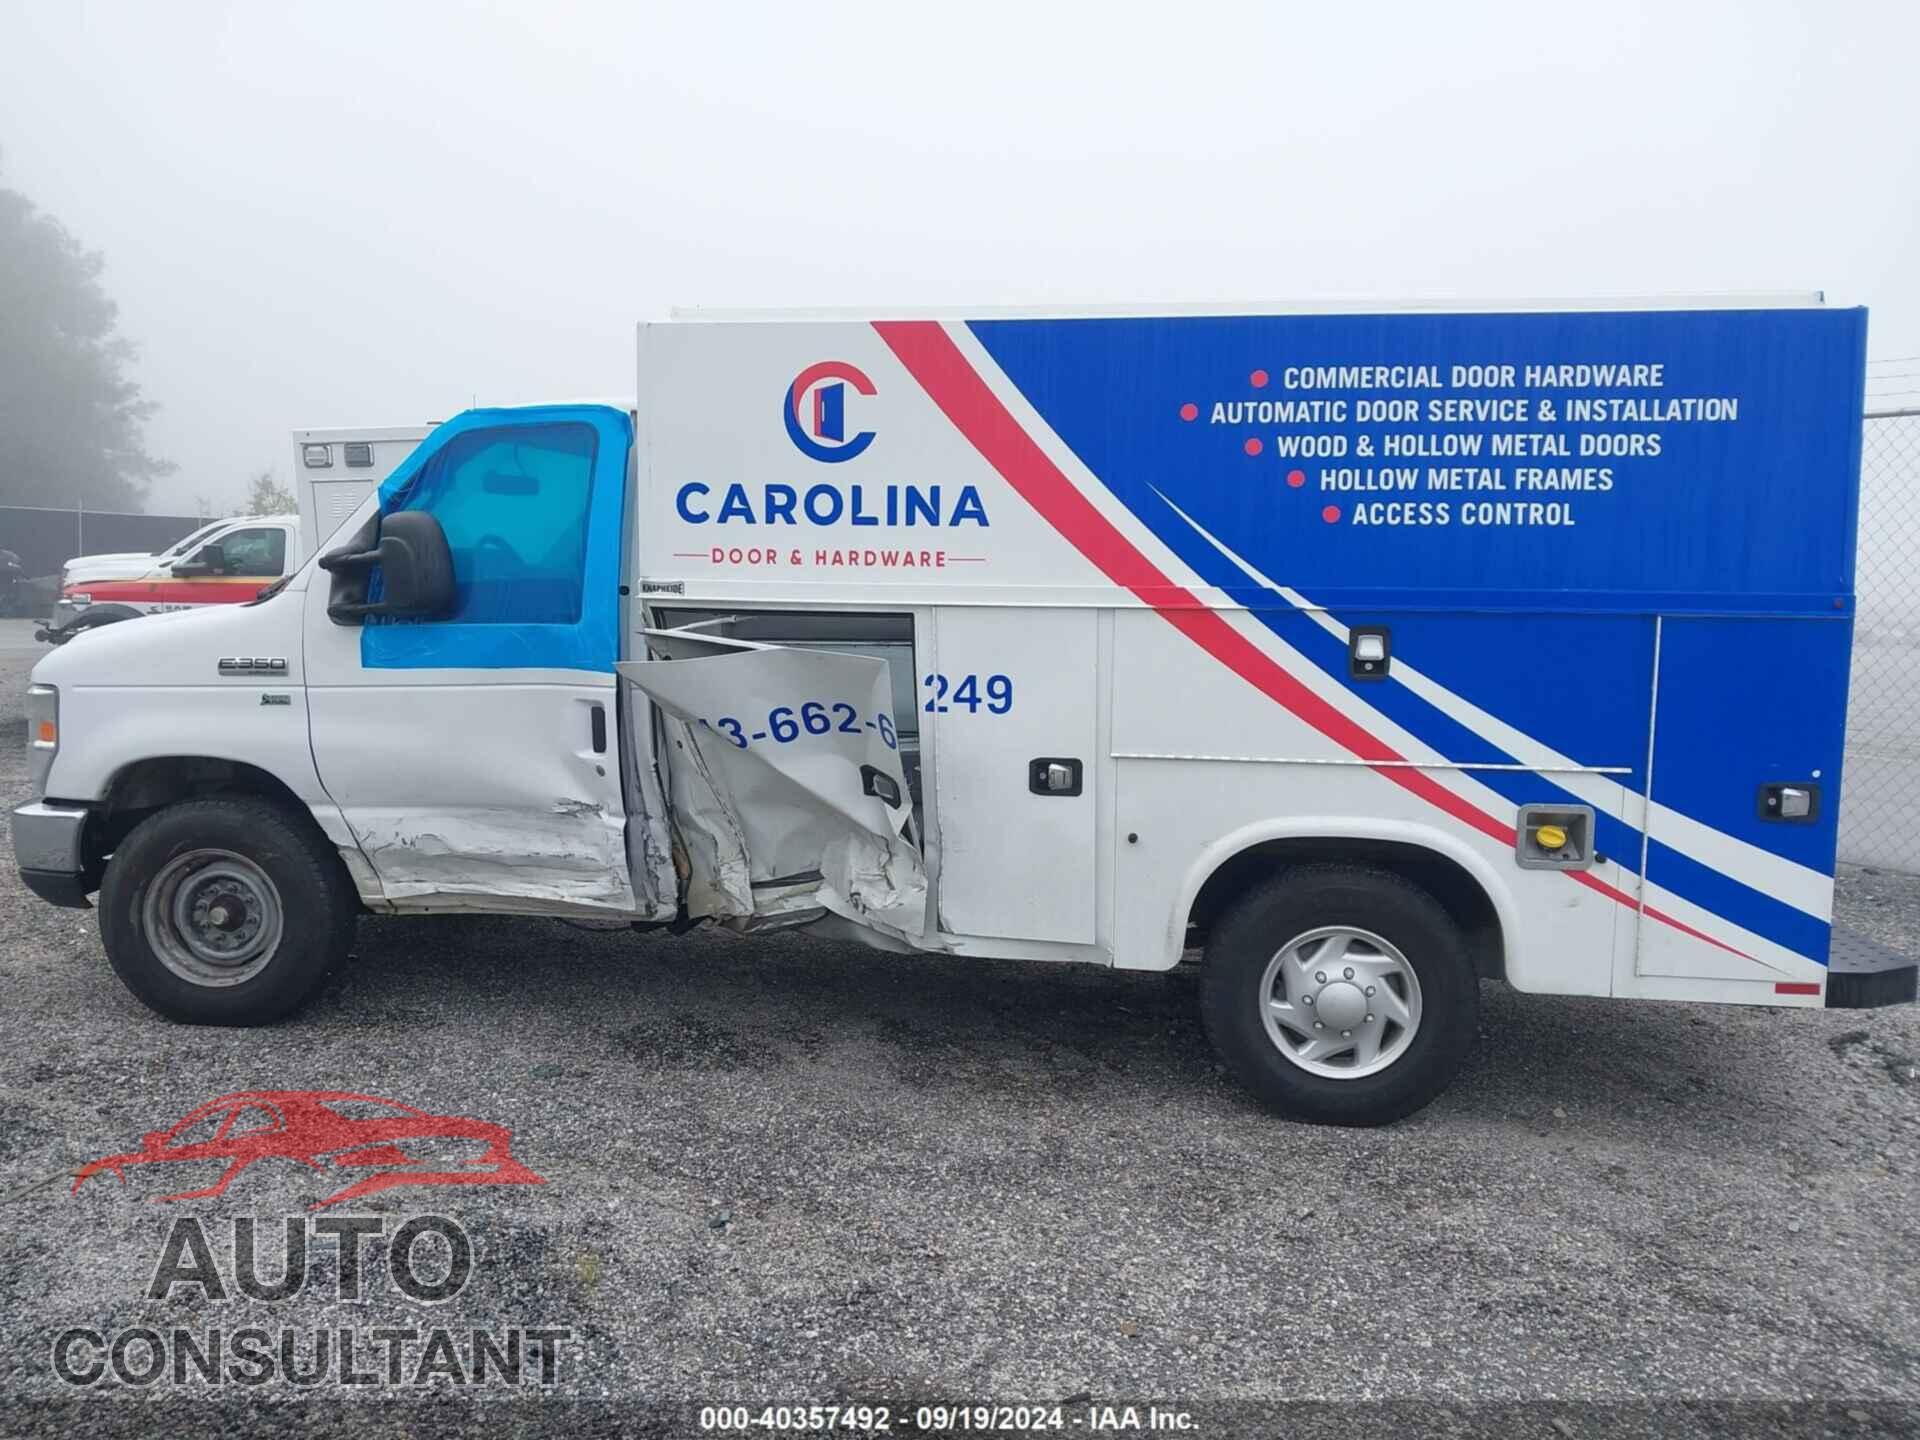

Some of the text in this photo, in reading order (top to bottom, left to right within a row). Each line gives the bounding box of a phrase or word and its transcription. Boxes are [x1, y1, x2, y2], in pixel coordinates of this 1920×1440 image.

[1284, 364, 1664, 389] COMMERCIAL DOOR HARDWARE
[1210, 398, 1738, 424] AUTOMATIC DOOR SERVICE & INSTALLATION
[1277, 433, 1662, 457] WOOD & HOLLOW METAL DOORS
[1320, 468, 1613, 491] HOLLOW METAL FRAMES
[676, 481, 990, 527] CAROLINA
[1352, 502, 1575, 525] ACCESS CONTROL
[711, 548, 945, 567] DOOR & HARDWARE
[924, 674, 1013, 714] 249
